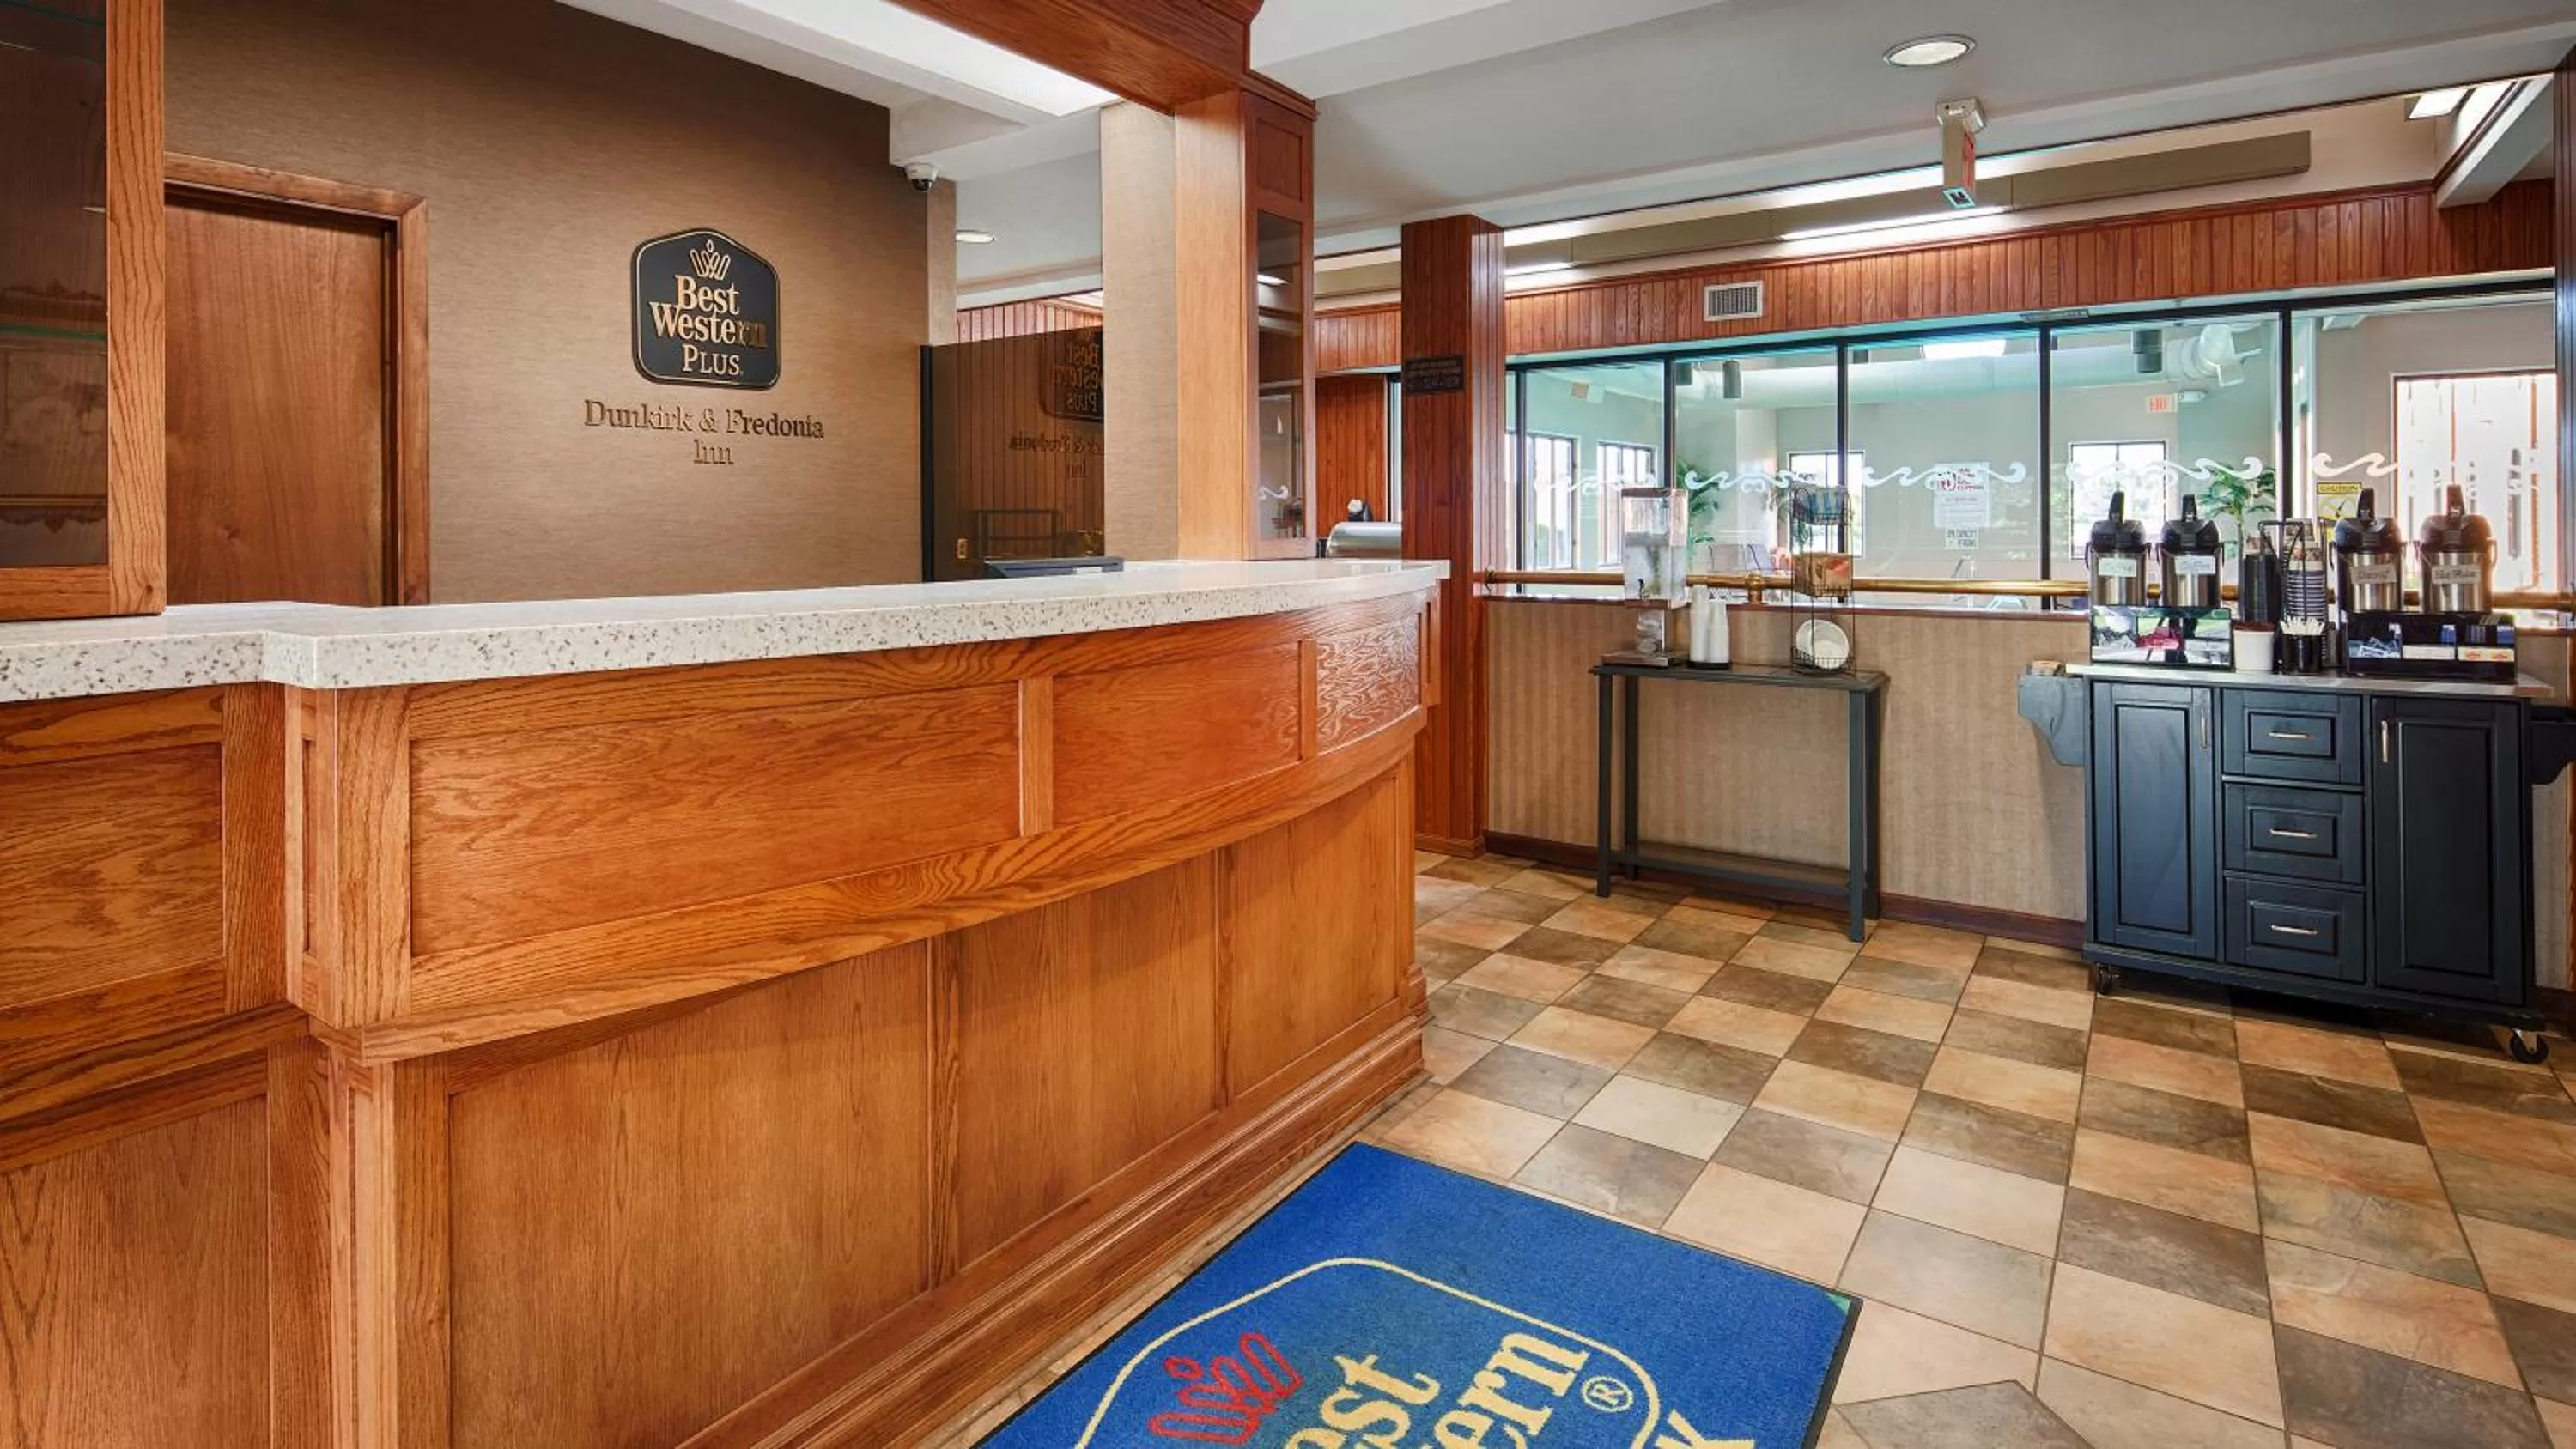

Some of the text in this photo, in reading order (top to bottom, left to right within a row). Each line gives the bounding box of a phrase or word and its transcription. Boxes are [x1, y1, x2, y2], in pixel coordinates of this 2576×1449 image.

[675, 274, 740, 315] Best
[648, 301, 768, 348] Western
[682, 344, 740, 376] PLUS
[585, 399, 825, 439] Dunkirk & Fredonia
[693, 439, 735, 465] Inn
